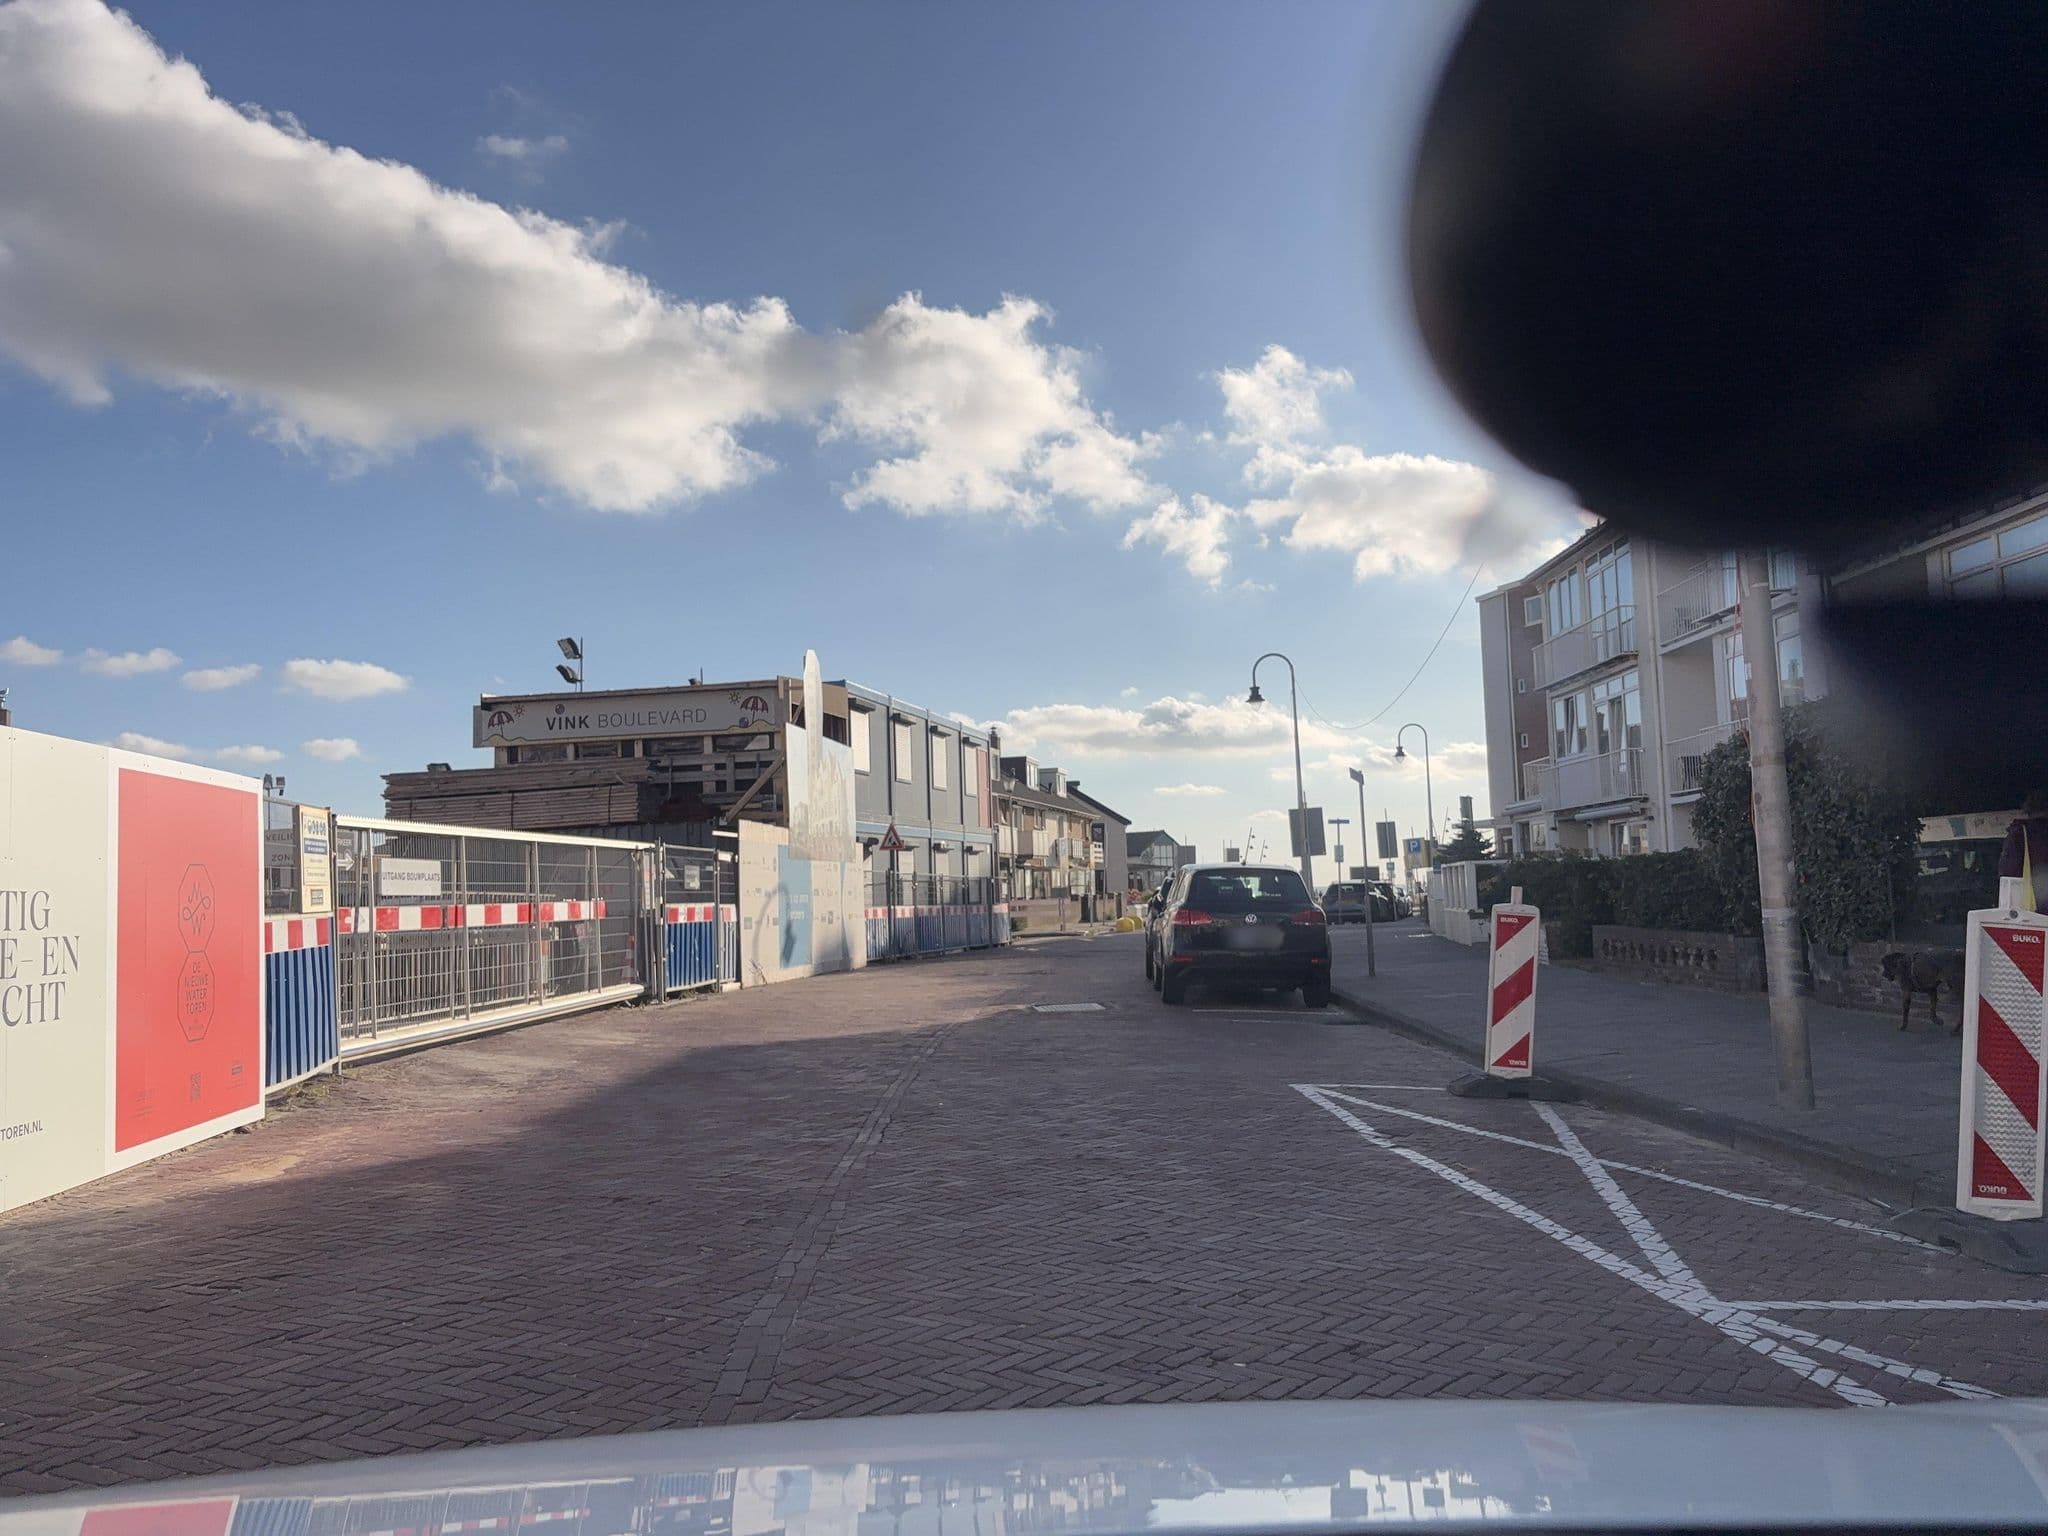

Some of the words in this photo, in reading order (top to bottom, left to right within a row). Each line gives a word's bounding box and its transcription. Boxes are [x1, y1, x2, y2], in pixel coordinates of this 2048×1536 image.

[546, 714, 590, 730] VINK
[598, 709, 707, 728] BOULEVARD
[186, 988, 208, 1002] WATER
